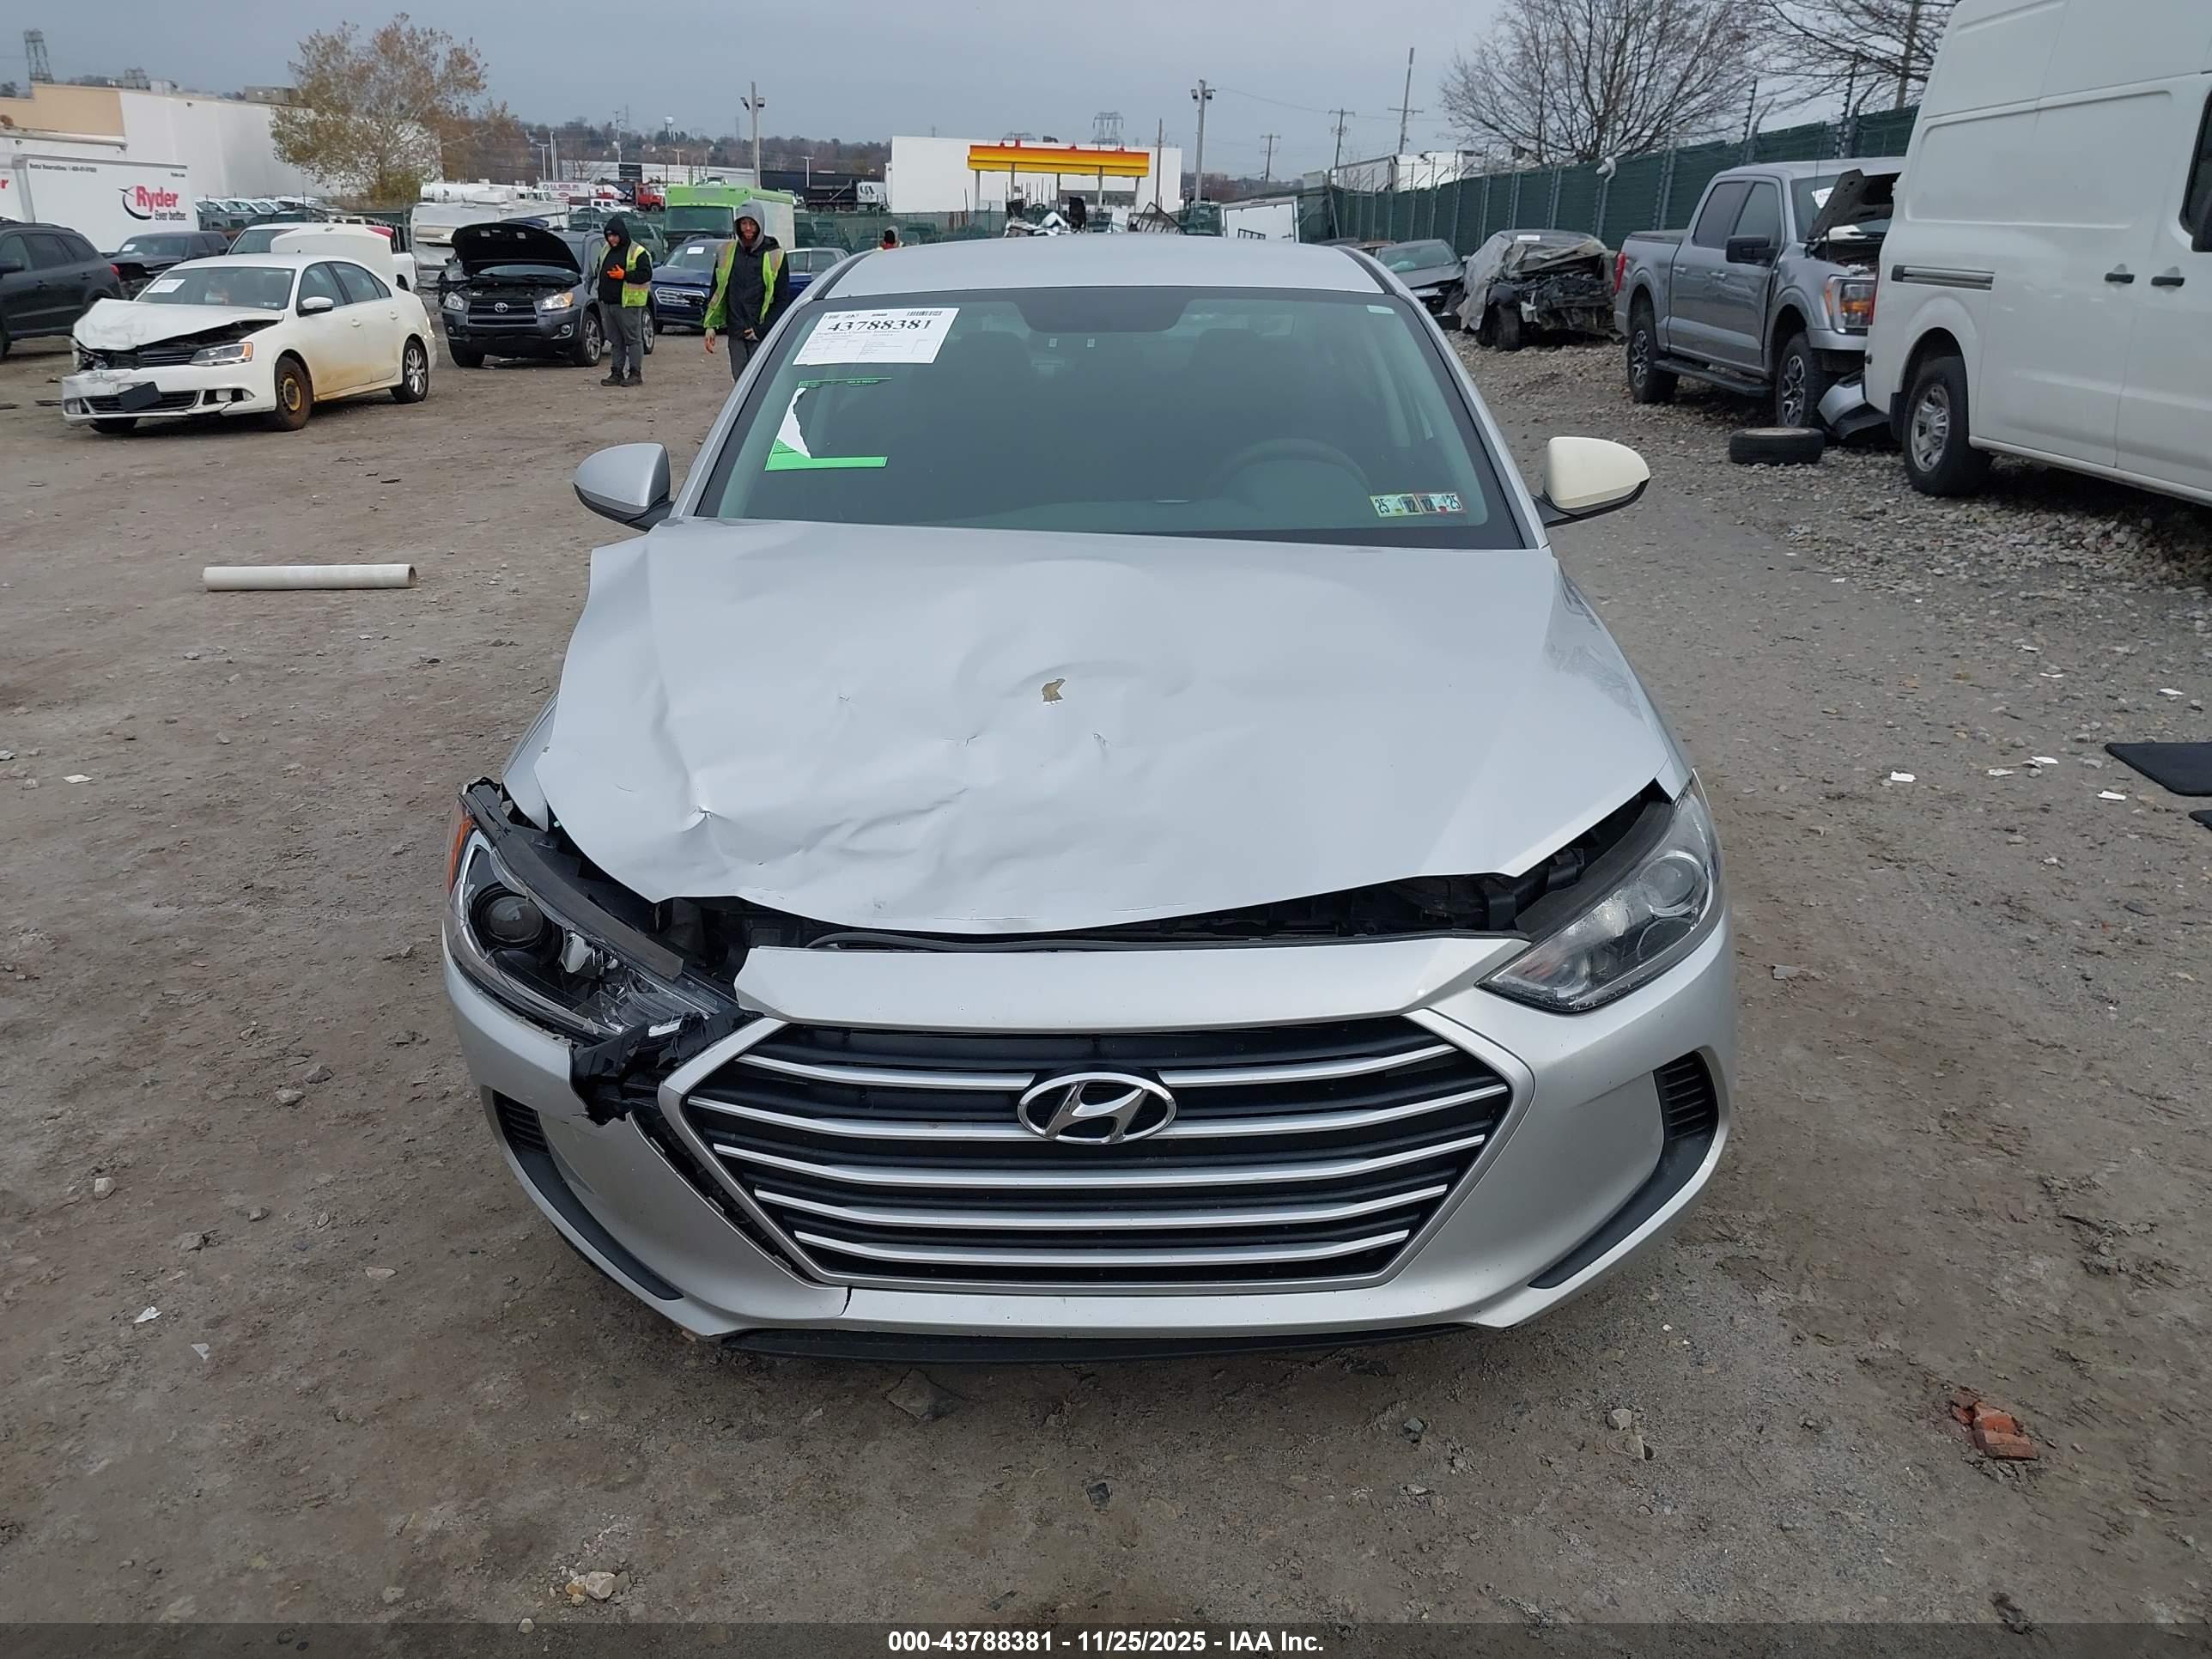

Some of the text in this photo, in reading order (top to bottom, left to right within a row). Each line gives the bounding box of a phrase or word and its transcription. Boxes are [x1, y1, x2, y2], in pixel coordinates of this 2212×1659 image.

[137, 185, 179, 212] Ryder
[155, 210, 167, 221] Ever
[827, 319, 932, 331] 43788381
[1375, 498, 1390, 514] 25
[1446, 495, 1462, 509] 25
